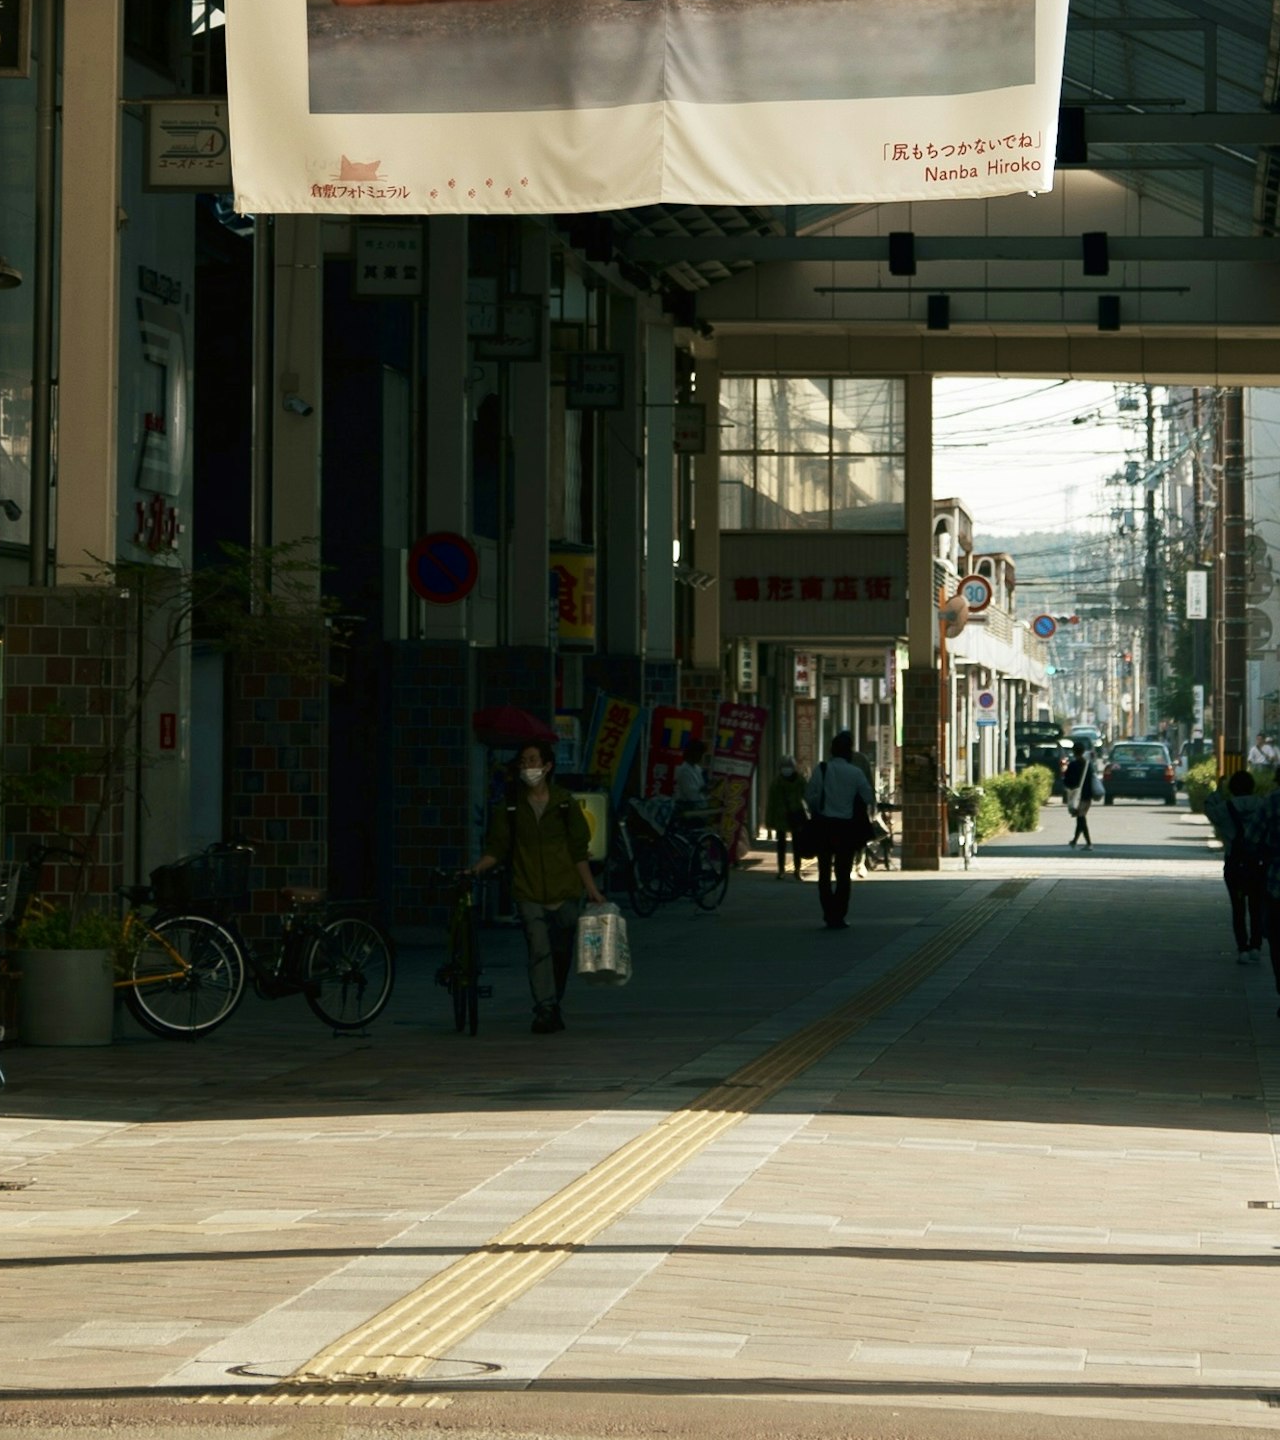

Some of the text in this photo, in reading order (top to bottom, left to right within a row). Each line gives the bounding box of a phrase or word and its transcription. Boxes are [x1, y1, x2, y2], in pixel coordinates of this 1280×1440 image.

[883, 130, 1042, 161] 「尻もちつかないでね」
[925, 156, 1042, 182] Nanba Hiroko
[310, 183, 411, 199] 倉敷フォトミュラル
[965, 585, 983, 603] 30
[597, 704, 630, 772] 処方せ
